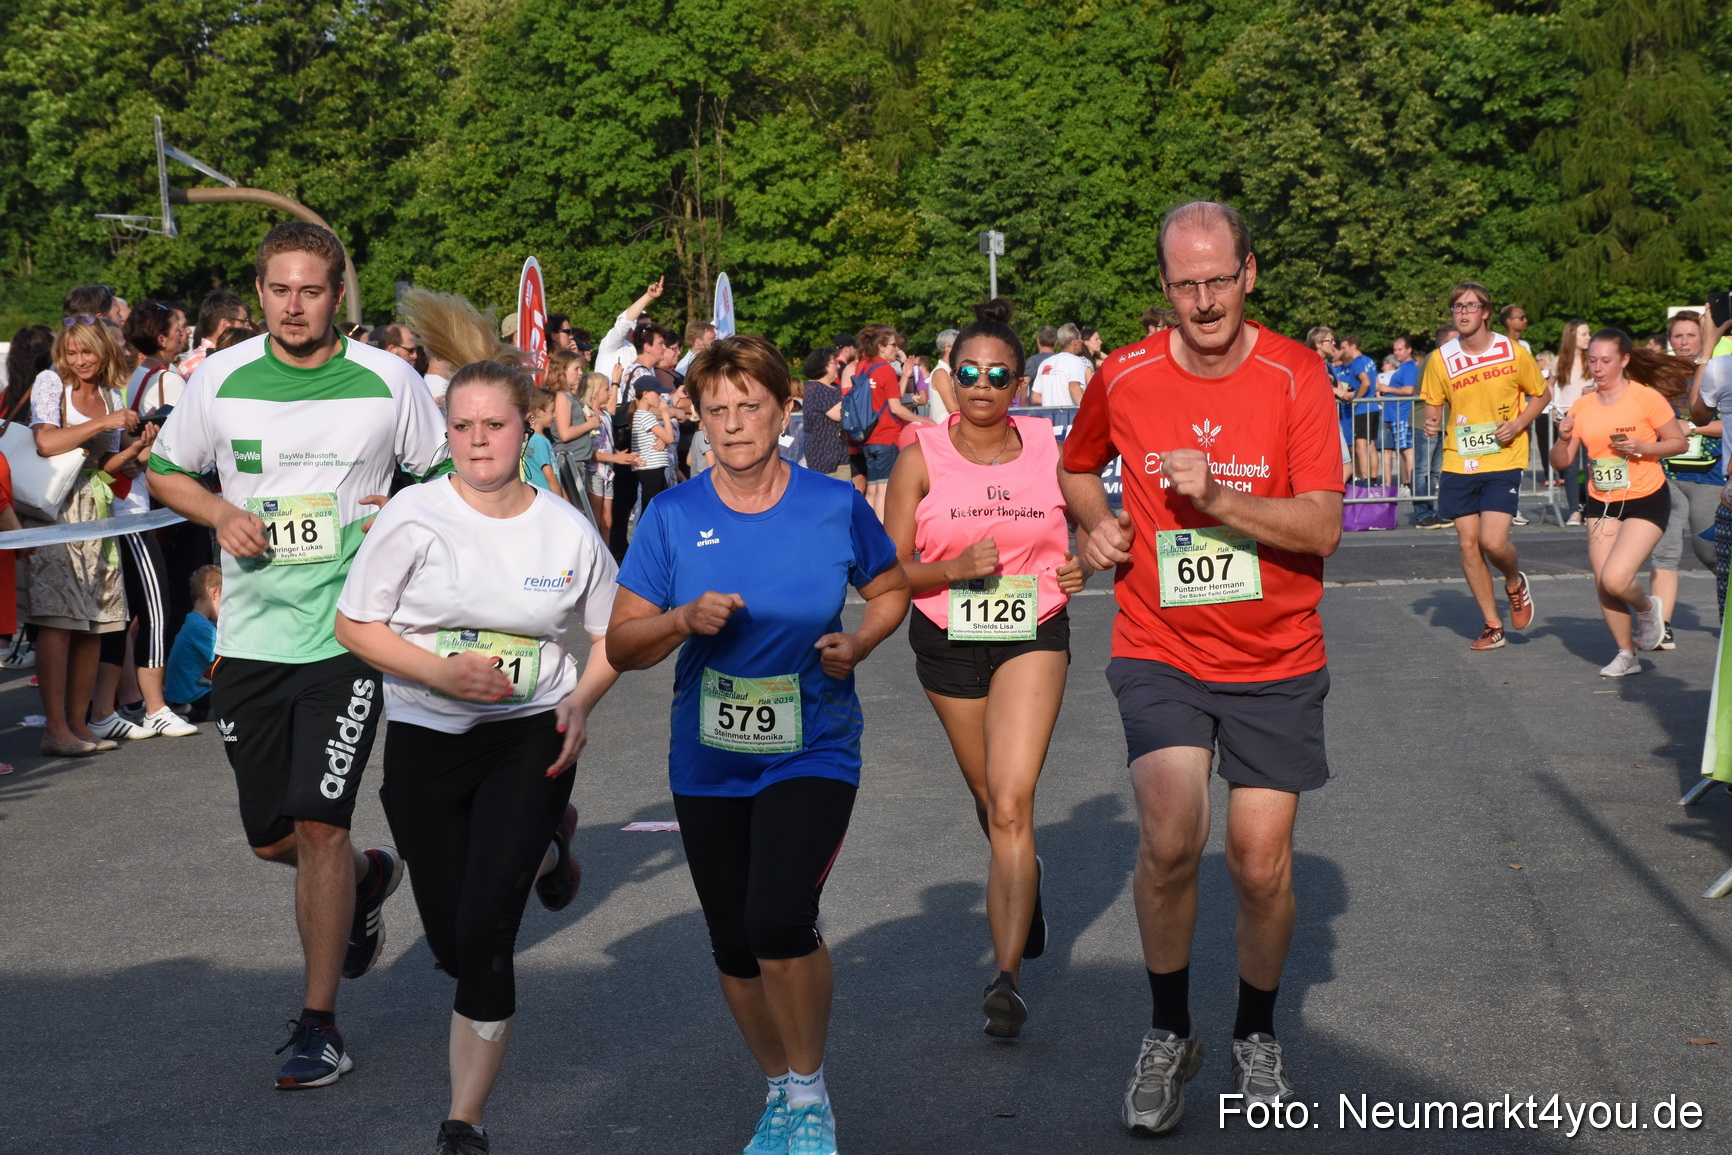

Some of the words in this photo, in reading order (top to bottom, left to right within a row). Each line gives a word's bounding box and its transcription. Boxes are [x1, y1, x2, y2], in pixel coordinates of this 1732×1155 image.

[1127, 348, 1146, 359] JAKO
[1452, 374, 1480, 392] MAX
[1483, 365, 1517, 381] BÖGL
[1462, 434, 1495, 449] 1645
[233, 450, 261, 462] BayWa
[279, 453, 304, 461] BayWa
[315, 460, 334, 468] gutes
[987, 486, 1011, 501] Die
[951, 505, 1045, 521] Kieferorthopäden
[266, 519, 318, 546] 118
[301, 543, 323, 551] Lukas
[697, 538, 720, 547] erima
[1170, 543, 1208, 553] firmenlauf
[1232, 543, 1251, 551] 2019
[1177, 553, 1234, 584] 607
[524, 576, 566, 588] reindl
[1174, 585, 1207, 593] Püntzner
[1209, 581, 1245, 591] Hermann
[960, 599, 1026, 623] 1126
[972, 622, 998, 630] Shields
[451, 638, 493, 650] firmenlauf
[712, 686, 749, 700] firmenlauf
[774, 696, 794, 704] 2019
[718, 702, 776, 733] 579
[320, 678, 375, 799] adidas
[714, 728, 751, 741] Steinmetz
[753, 733, 783, 741] Monika
